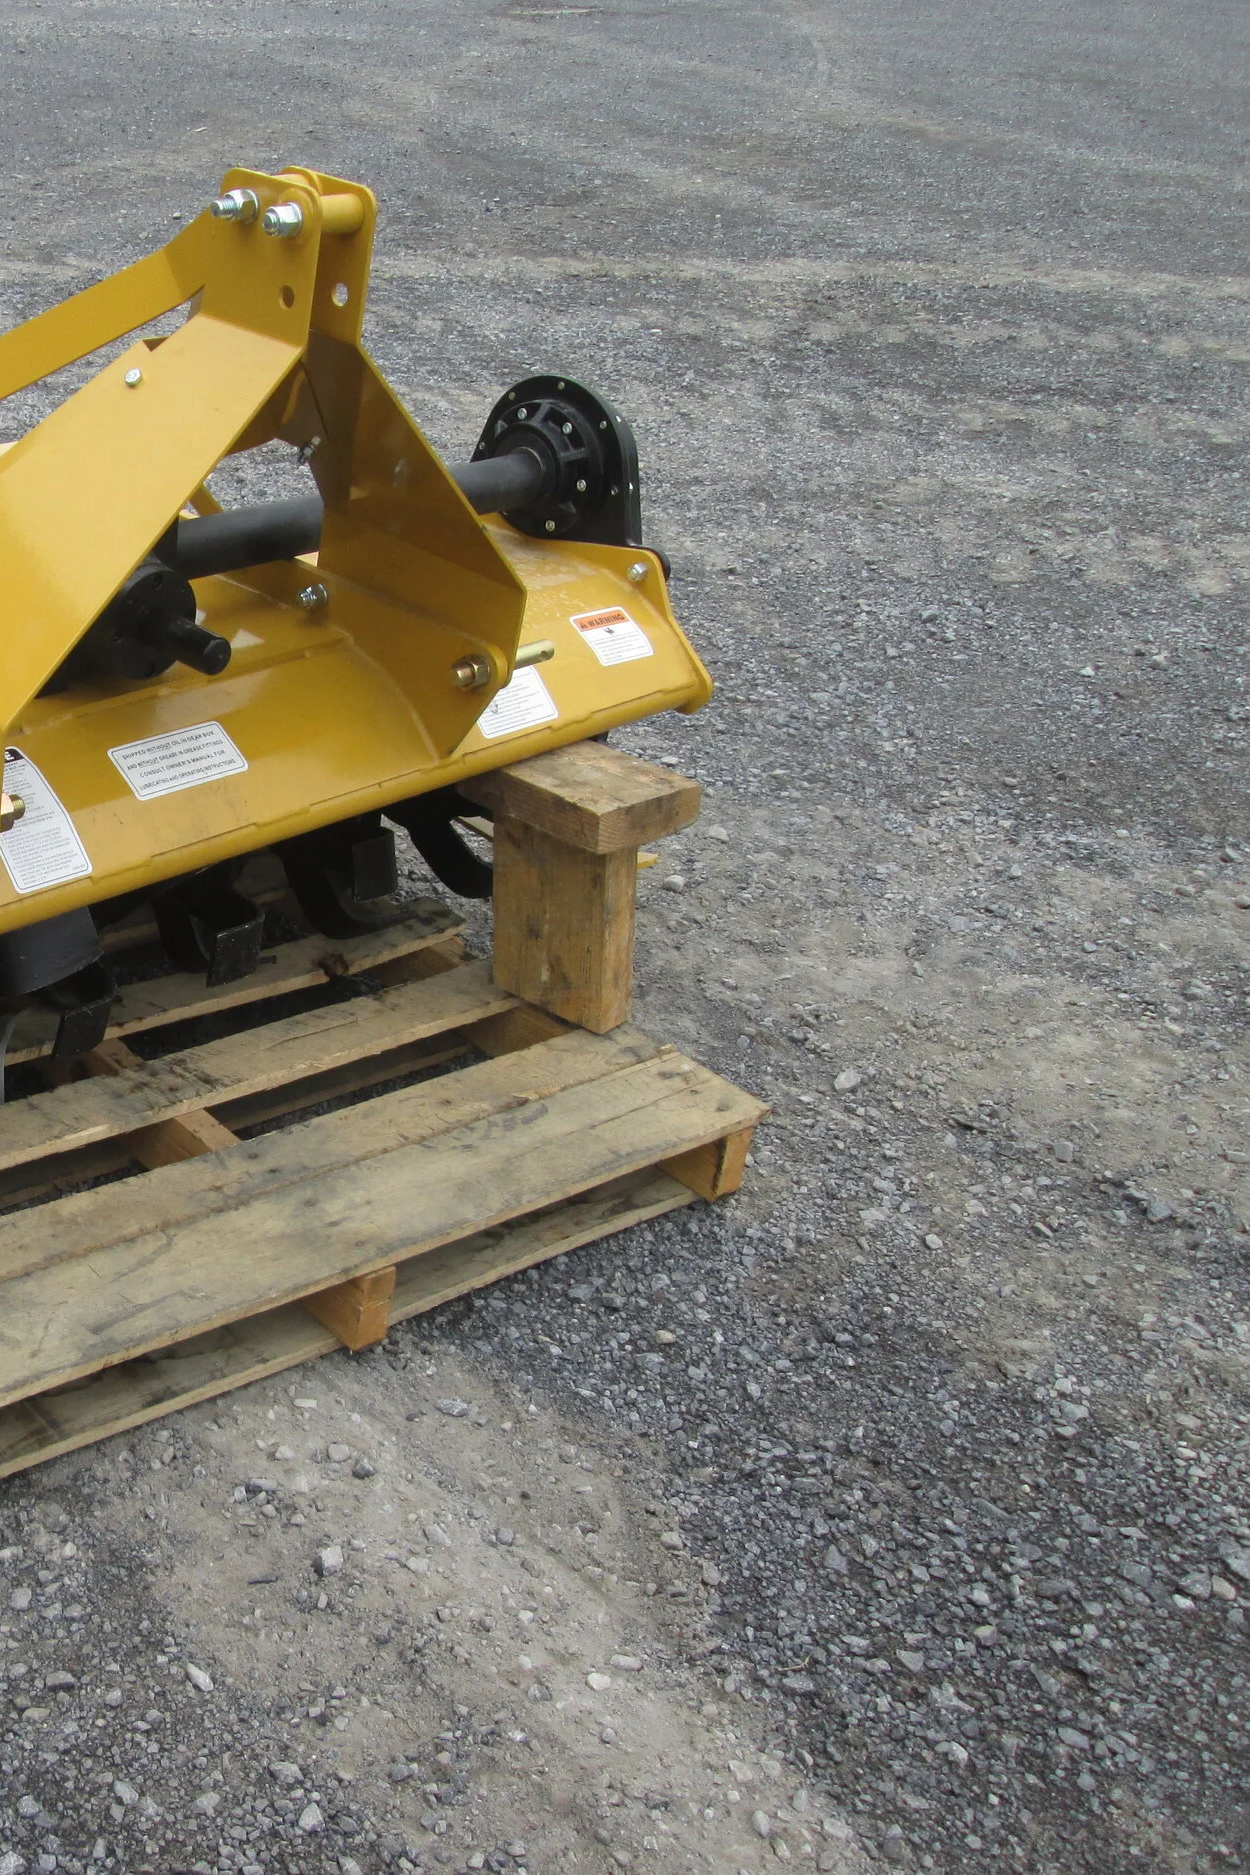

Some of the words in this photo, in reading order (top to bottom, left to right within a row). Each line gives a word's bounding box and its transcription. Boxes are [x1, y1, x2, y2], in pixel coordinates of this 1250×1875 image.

[588, 613, 625, 627] WARNING
[122, 750, 145, 759] SHIPPED
[146, 743, 171, 752] WITHOUT
[137, 757, 159, 766] WITHOUT
[158, 752, 178, 761] GREASE
[139, 767, 165, 777] CONSULT
[191, 753, 214, 763] MANUAL
[138, 777, 169, 789] LUBRICATING
[178, 767, 204, 778] OPERATING
